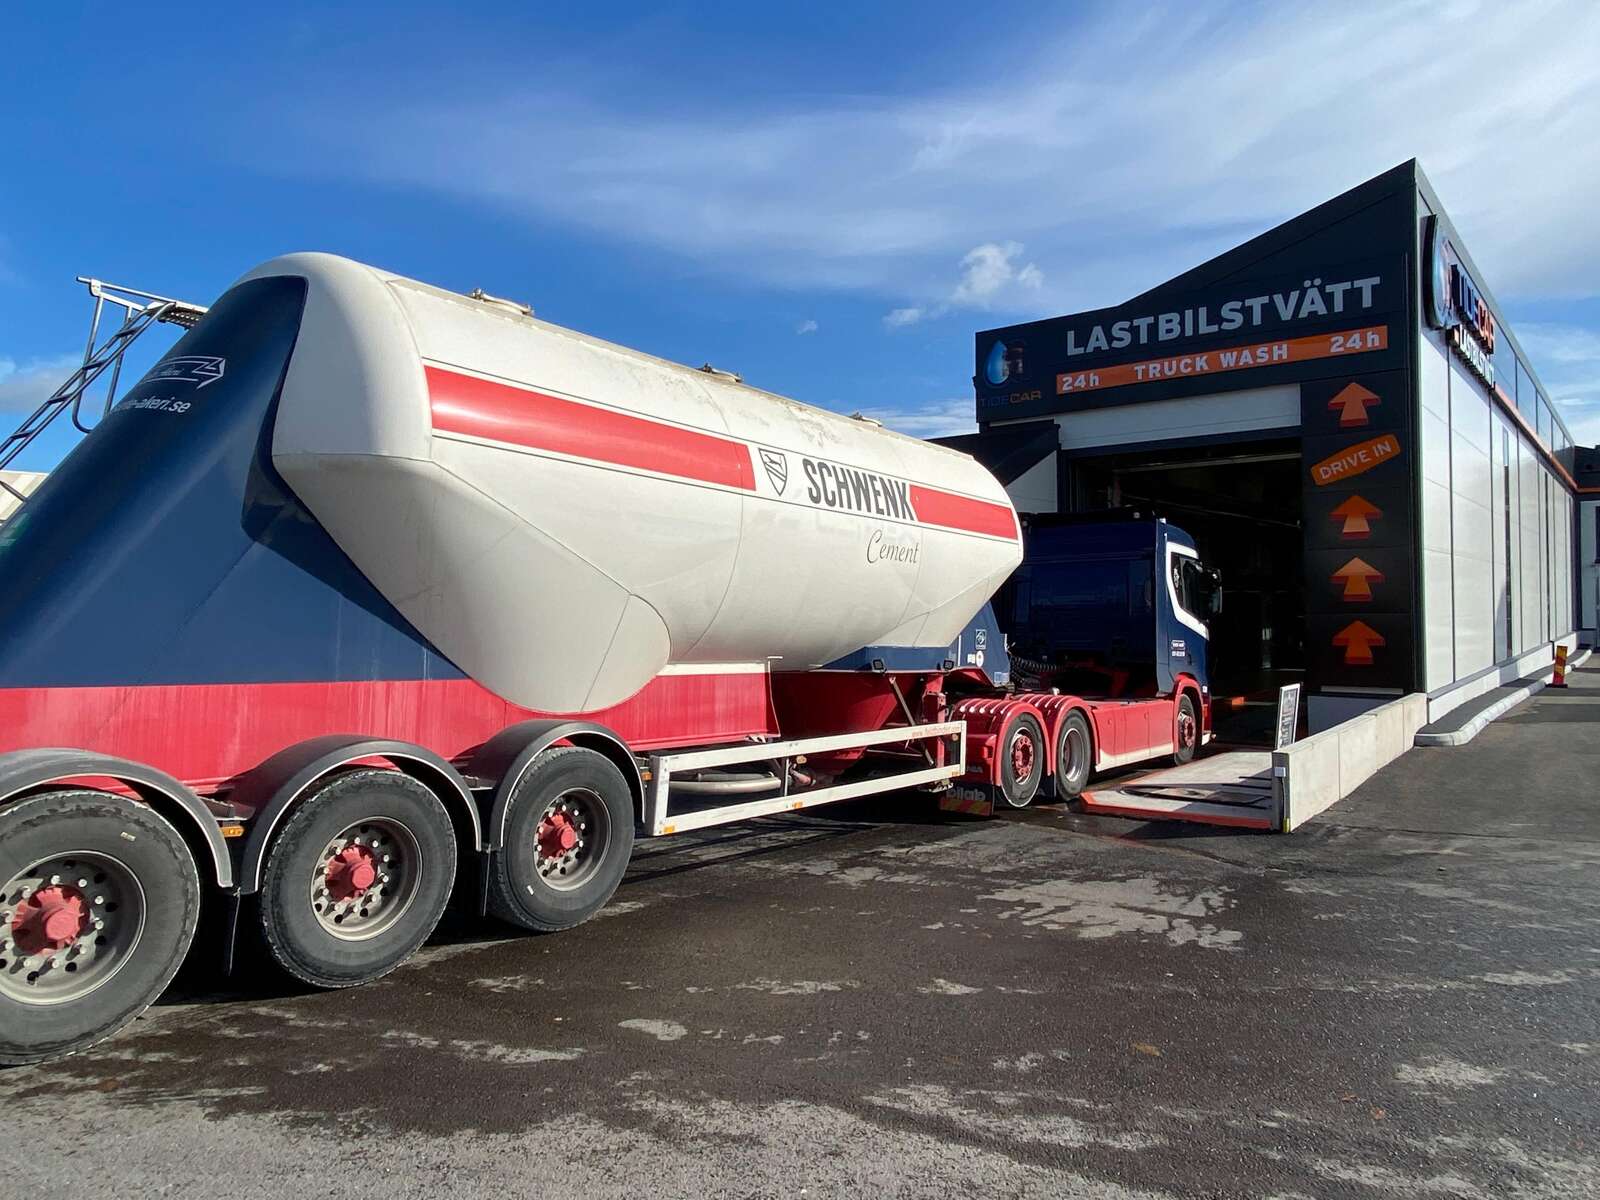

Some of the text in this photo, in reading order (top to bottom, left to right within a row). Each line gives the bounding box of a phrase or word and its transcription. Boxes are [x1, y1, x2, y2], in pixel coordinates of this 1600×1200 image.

[1066, 276, 1381, 356] LASTBILSTVÄTT
[1062, 373, 1100, 391] 24h
[1134, 355, 1209, 380] TRUCK
[1220, 344, 1288, 368] WASH
[1320, 441, 1392, 479] DRIVE IN
[802, 458, 915, 521] SCHWENK
[866, 529, 919, 564] Cement
